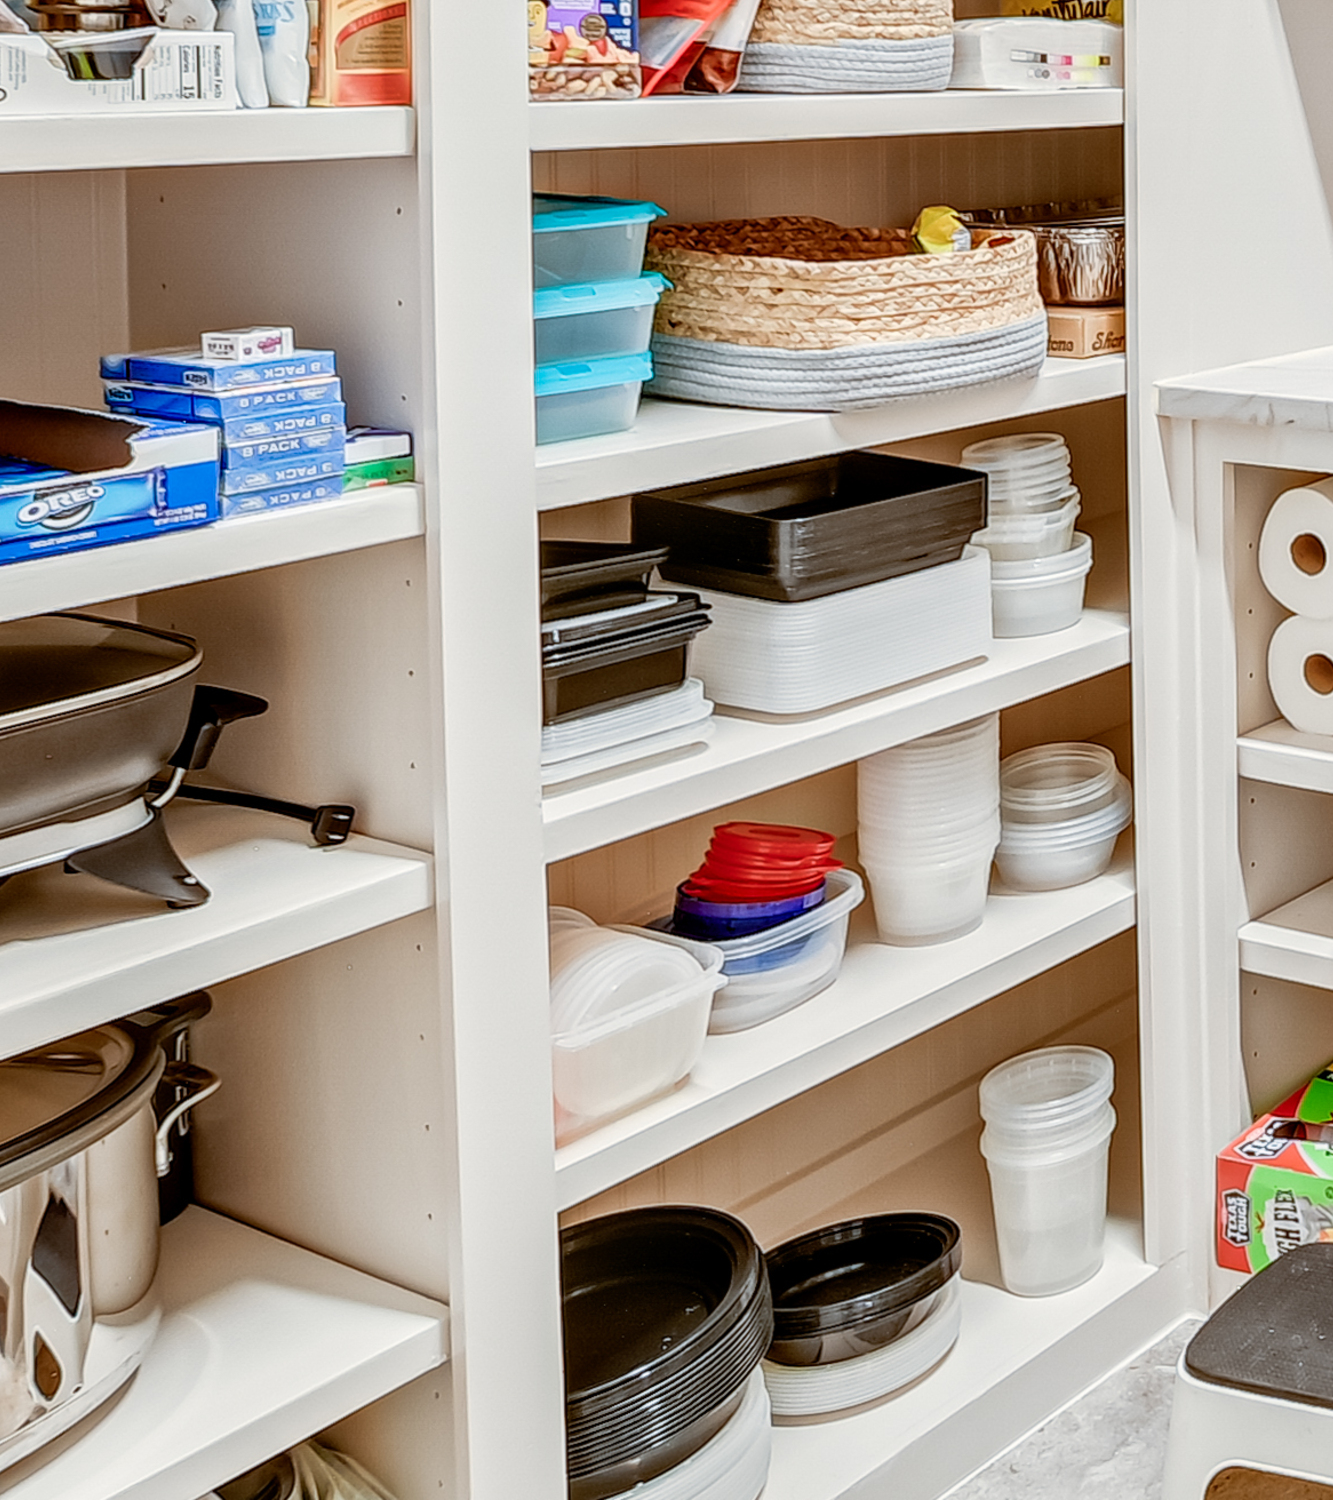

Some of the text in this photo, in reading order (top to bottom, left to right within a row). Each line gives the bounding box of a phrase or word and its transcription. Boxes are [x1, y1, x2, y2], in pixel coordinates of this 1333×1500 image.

[183, 85, 196, 100] 15
[263, 364, 306, 379] PACK
[253, 391, 296, 406] PACK
[274, 416, 316, 431] PACK
[258, 439, 301, 455] PACK
[275, 465, 317, 480] PACK
[17, 485, 106, 525] OREO
[269, 489, 312, 505] PACK
[1274, 1189, 1297, 1224] FLEX
[1226, 1194, 1237, 1245] TEXAS
[1236, 1194, 1250, 1244] TOUGH
